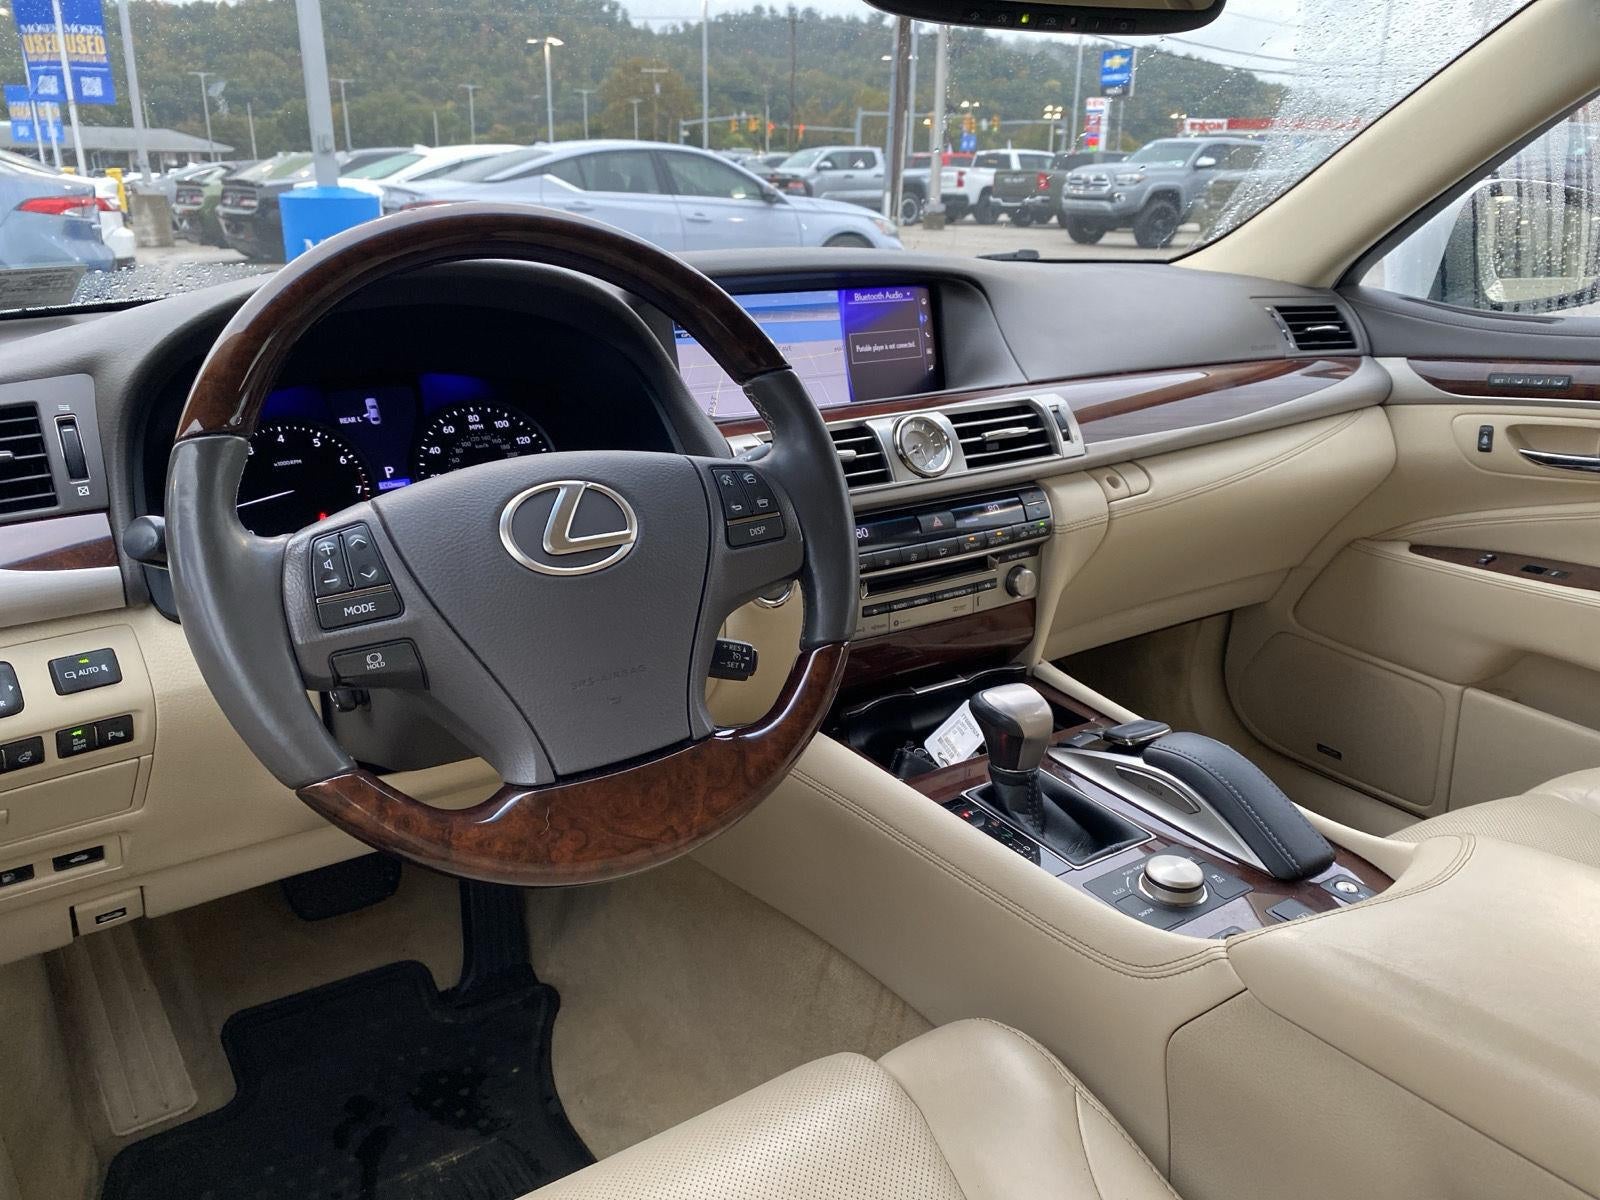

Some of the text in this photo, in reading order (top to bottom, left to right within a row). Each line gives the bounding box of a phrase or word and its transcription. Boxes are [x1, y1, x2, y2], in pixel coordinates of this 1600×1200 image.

[64, 34, 106, 54] USED
[854, 290, 904, 301] Bluetooth Audio
[339, 417, 357, 425] REAR
[468, 414, 480, 423] 80
[494, 419, 510, 428] 100
[443, 425, 455, 434] 60
[277, 434, 285, 443] 4
[312, 438, 321, 447] 5
[516, 436, 531, 445] 120
[429, 446, 441, 454] 40
[339, 455, 347, 465] 6
[384, 466, 394, 479] P
[355, 485, 362, 494] 7
[749, 525, 766, 536] DISP
[856, 526, 869, 540] 80
[343, 602, 377, 617] MODE
[366, 661, 386, 671] HOLD
[727, 661, 739, 669] SET
[78, 666, 99, 676] AUTO
